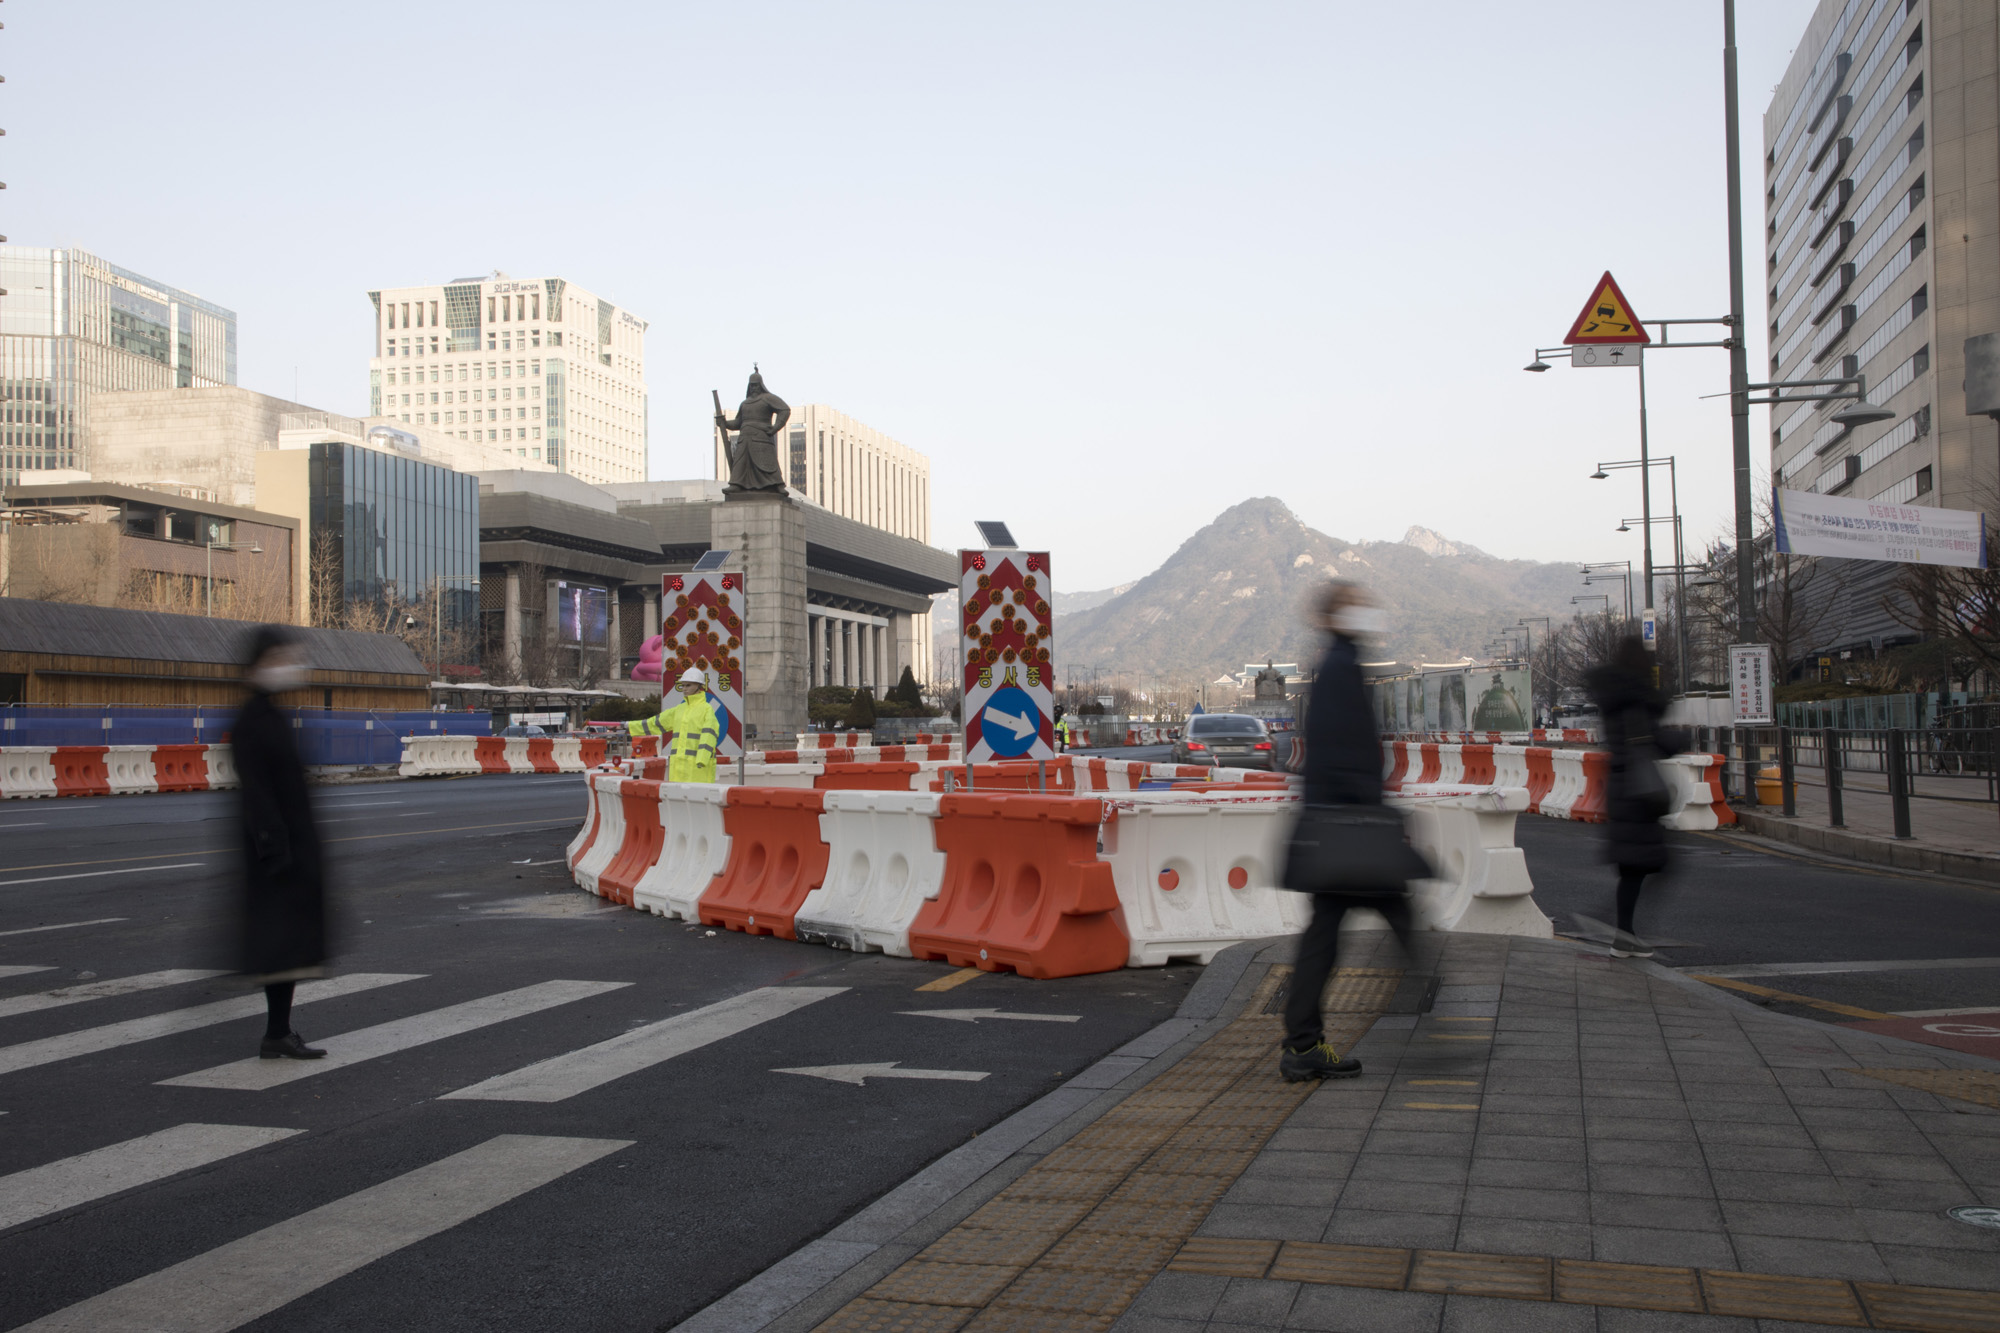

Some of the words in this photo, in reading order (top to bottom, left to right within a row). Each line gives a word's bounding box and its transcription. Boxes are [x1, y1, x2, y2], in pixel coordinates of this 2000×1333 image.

[494, 283, 519, 293] 외교부
[978, 665, 1041, 688] 공사중
[1739, 657, 1747, 679] 공사중
[1823, 668, 1829, 676] 3
[1740, 684, 1749, 713] 우회바람
[1754, 689, 1763, 713] 조성사업
